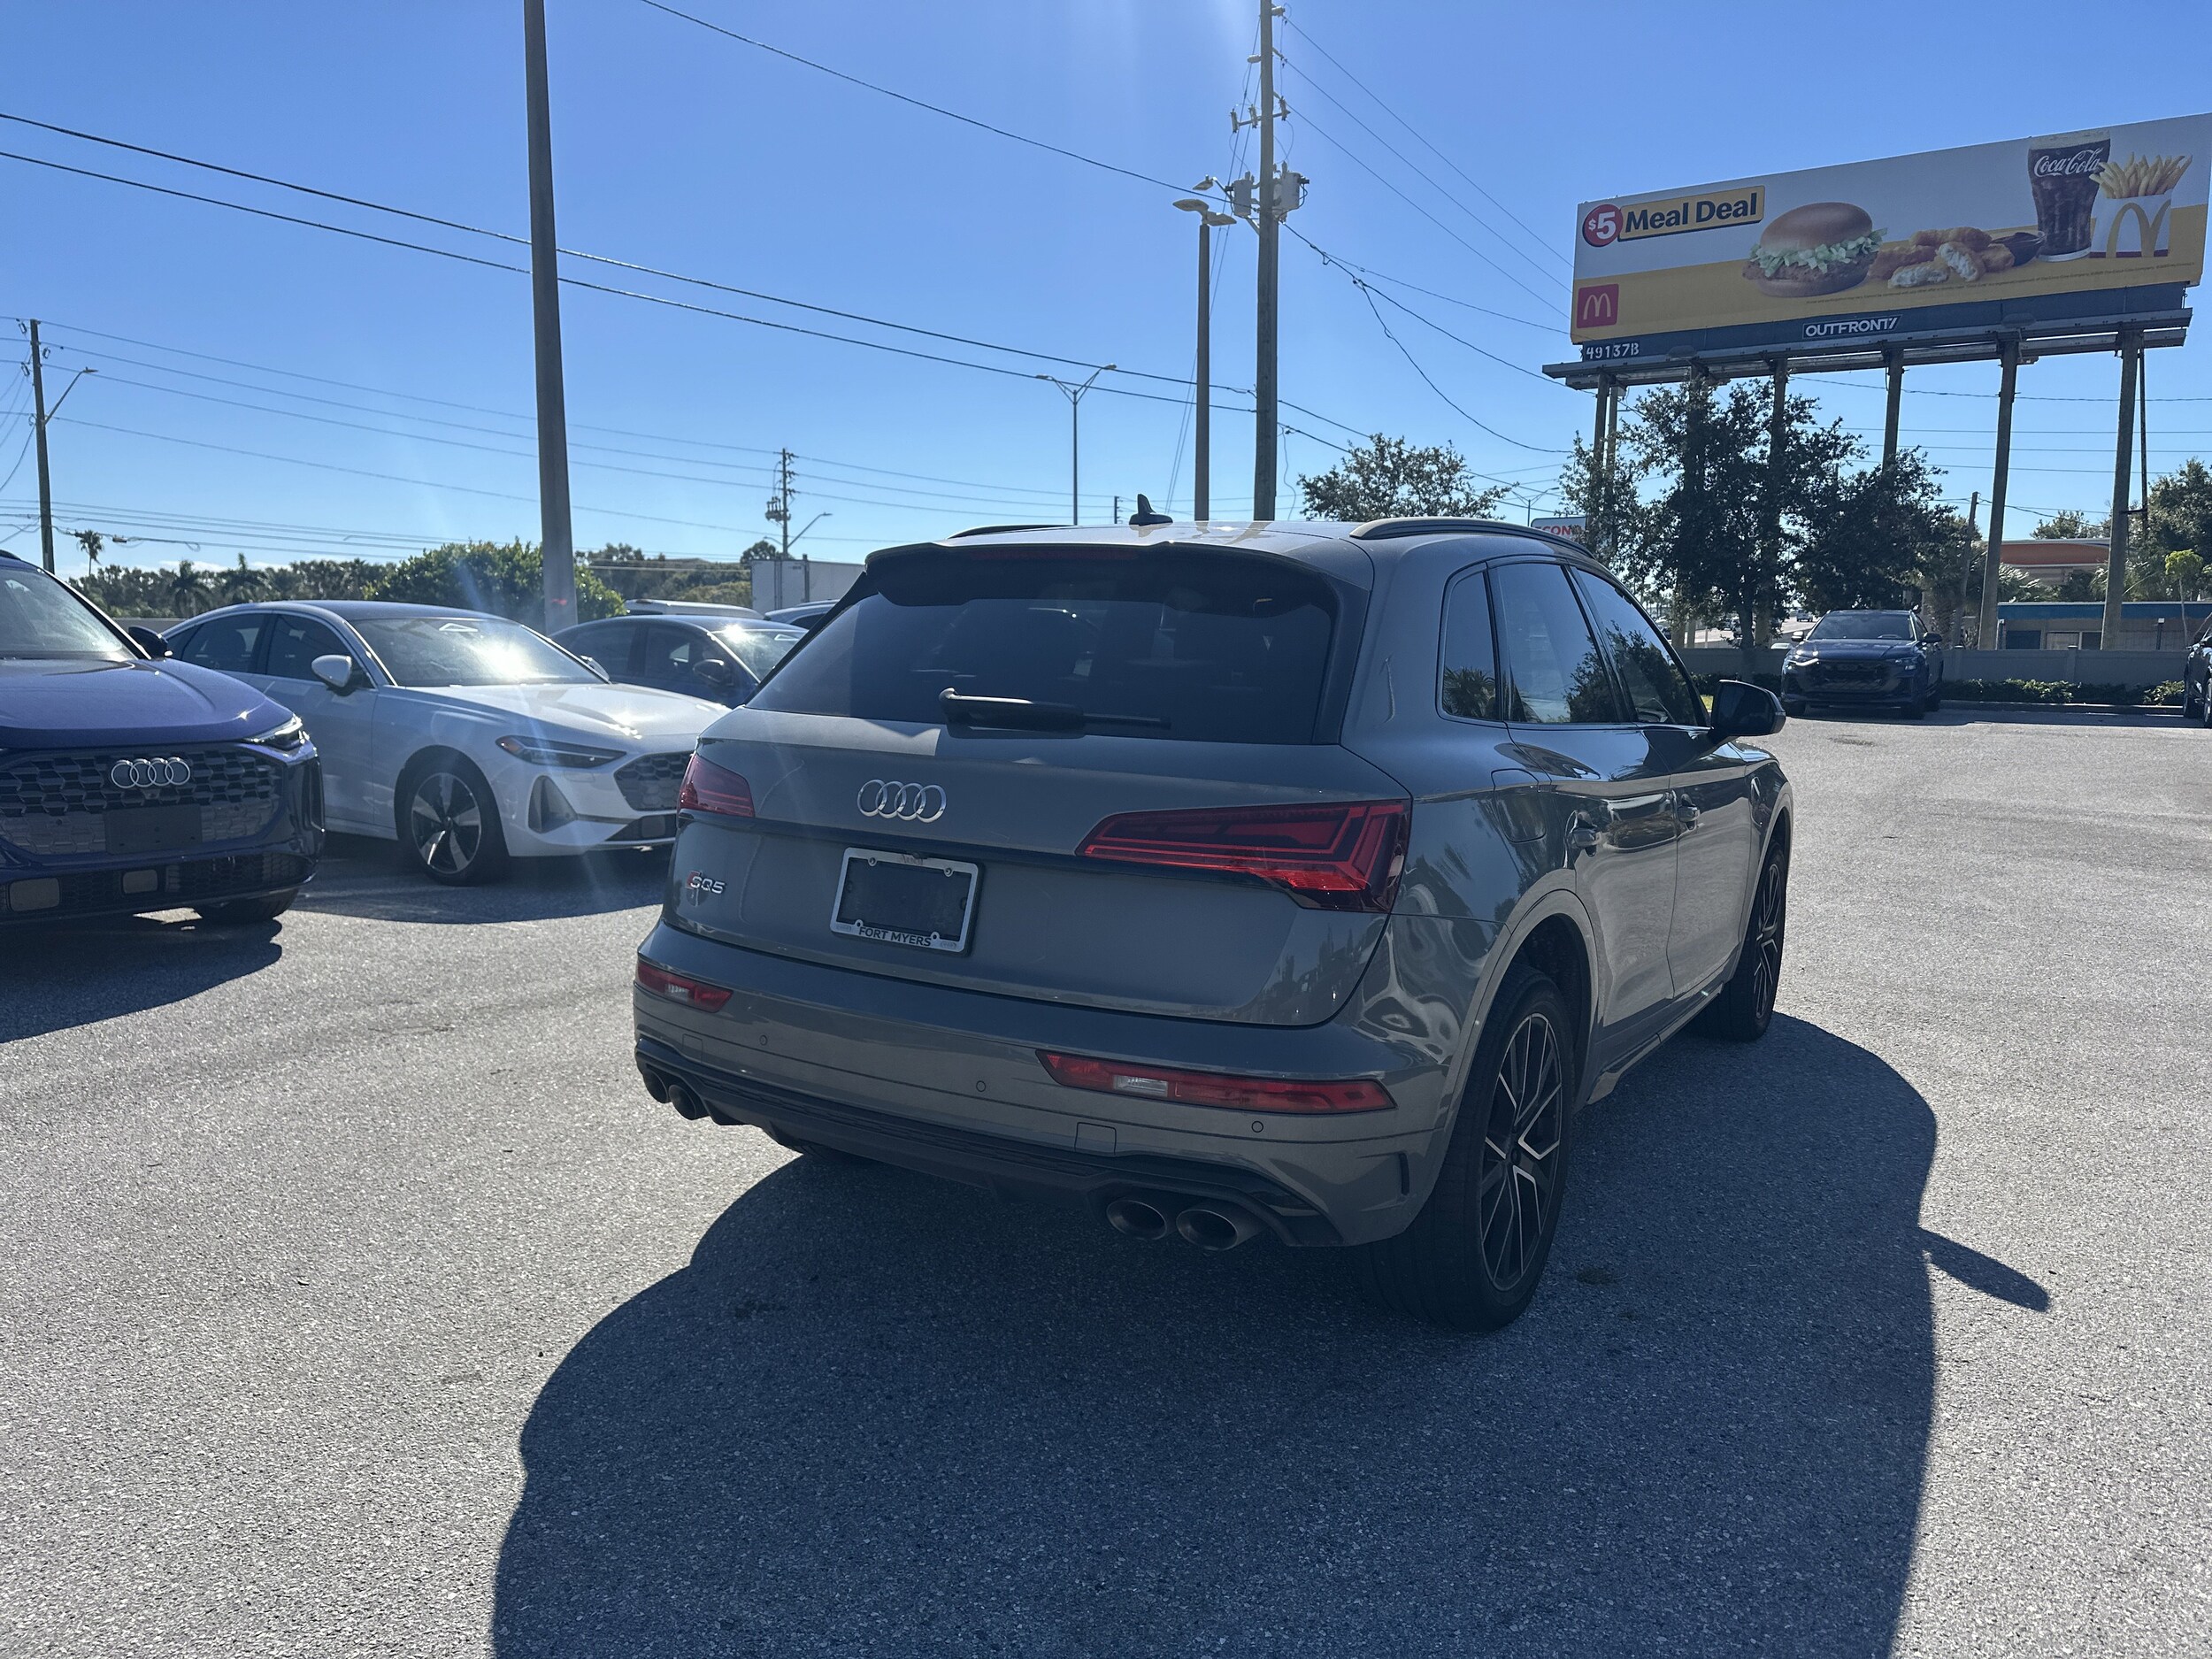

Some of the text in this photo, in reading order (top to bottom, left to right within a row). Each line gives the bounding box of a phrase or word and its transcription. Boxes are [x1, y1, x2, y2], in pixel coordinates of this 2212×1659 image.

[2033, 147, 2104, 178] Coca-Cola
[1587, 192, 1758, 240] $5 Meal Deal
[1586, 342, 1640, 359] 49137B
[688, 873, 726, 894] SQ5
[858, 926, 932, 947] FORT MYERS
